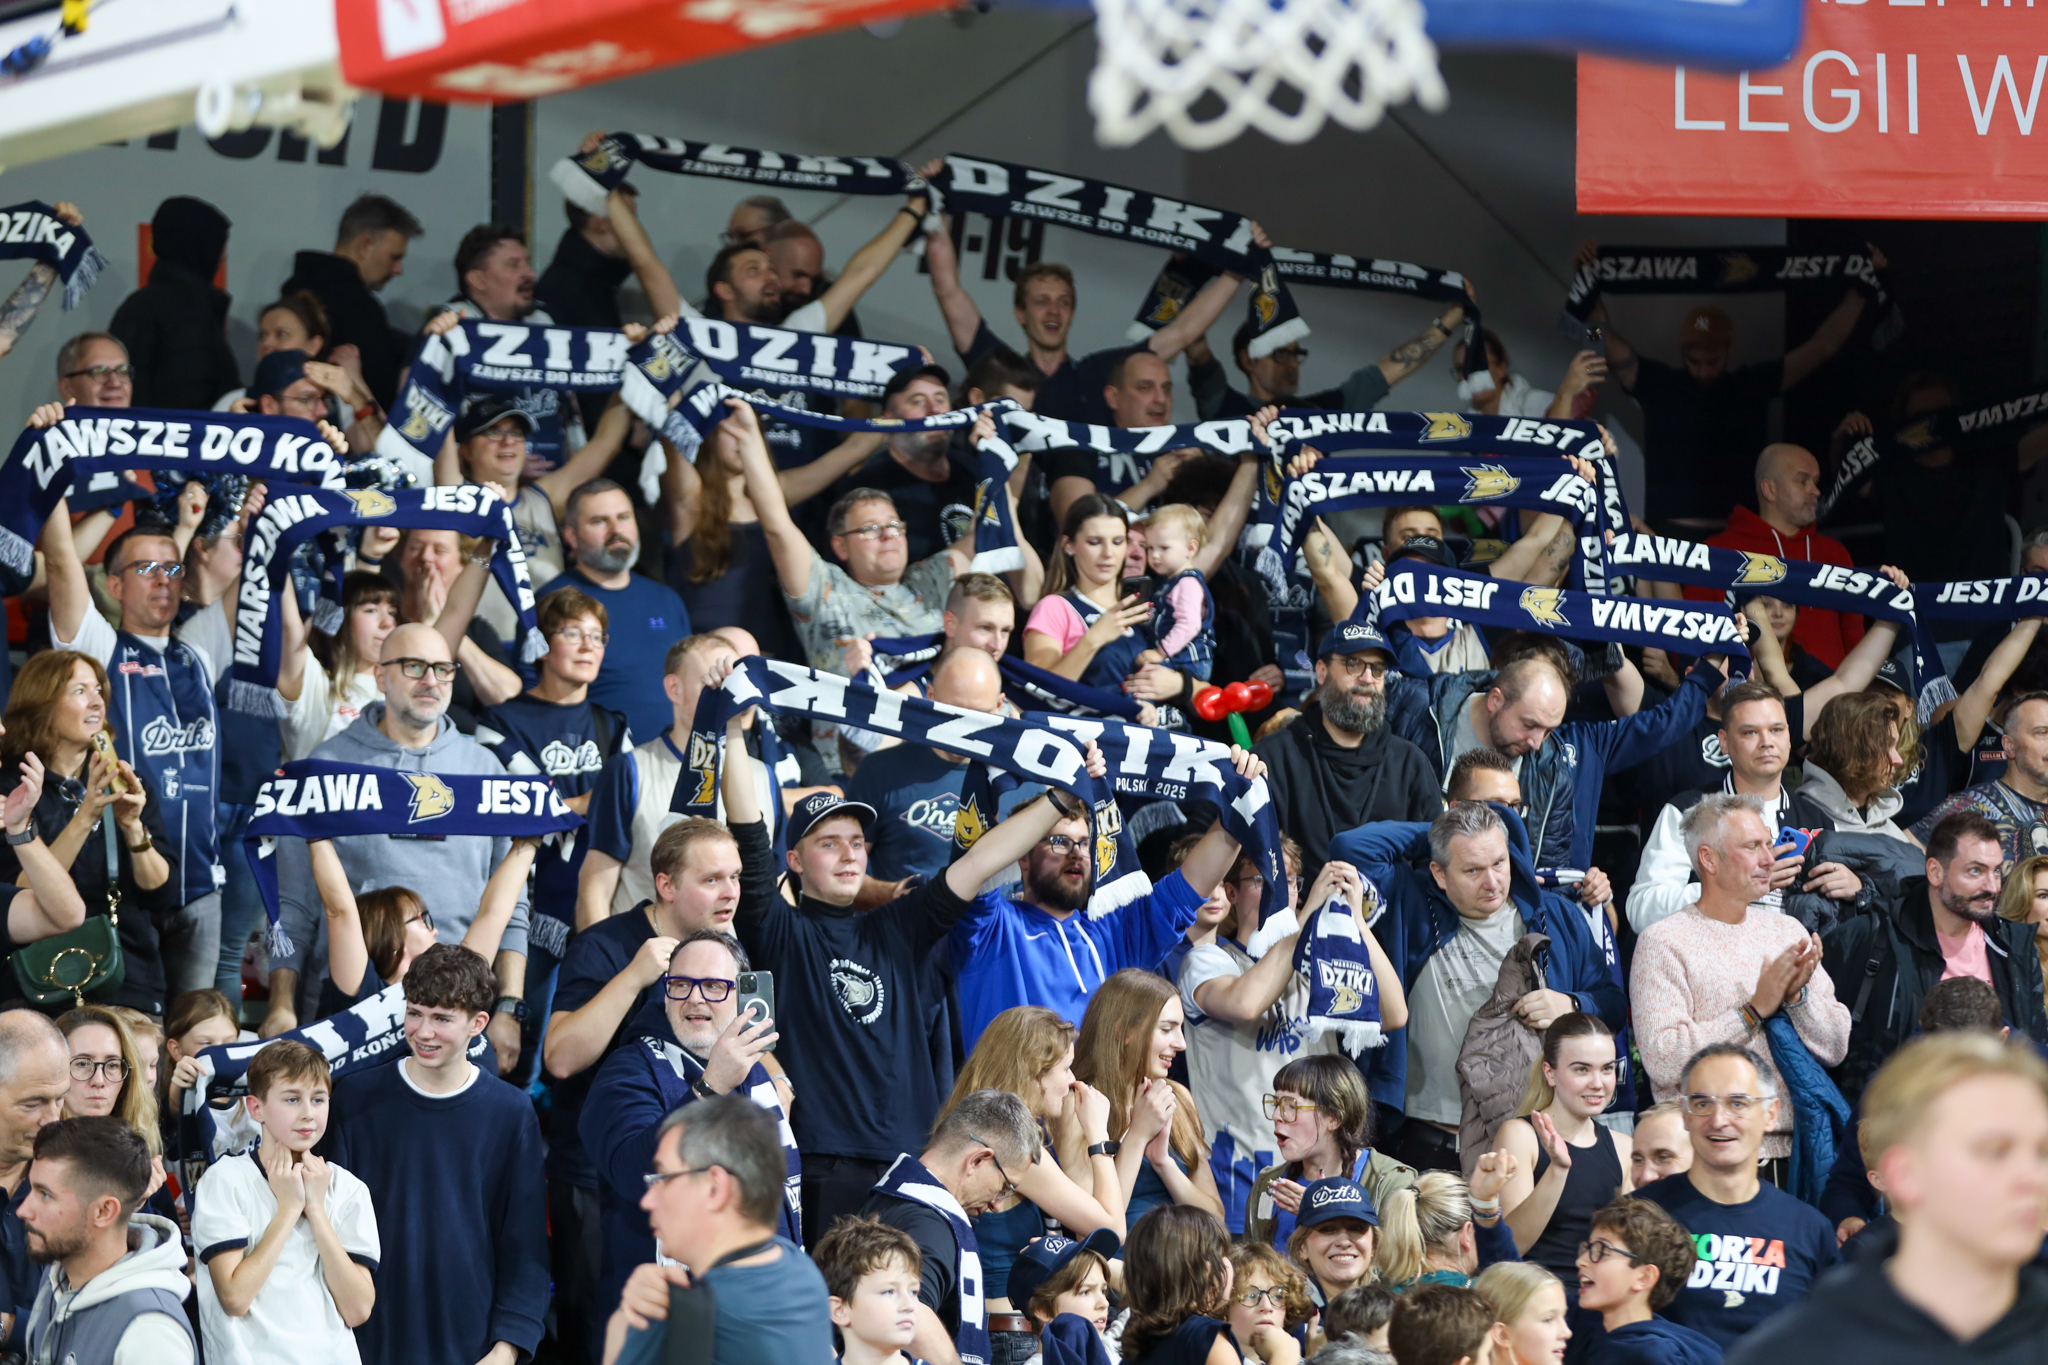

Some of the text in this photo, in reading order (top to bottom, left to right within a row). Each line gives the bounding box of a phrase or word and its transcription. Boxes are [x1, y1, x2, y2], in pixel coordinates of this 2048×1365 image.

[1675, 50, 1919, 134] LEGII
[1010, 200, 1093, 227] ZAWSZE
[1097, 217, 1125, 235] DO
[1276, 262, 1326, 278] WSZE
[1329, 267, 1354, 280] DO
[1775, 256, 1840, 280] JEST
[471, 363, 544, 384] ZAWSZE
[545, 369, 569, 385] DO
[740, 366, 809, 386] ZAWSZE
[810, 376, 833, 391] DO
[1496, 418, 1585, 450] JEST
[22, 418, 192, 491] ZAWSZE
[200, 424, 265, 465] DO
[233, 494, 330, 667] WARSZAWA
[421, 485, 501, 517] JEST
[1607, 533, 1896, 600] ZAWA JEST
[1423, 574, 1499, 610] JEST
[1936, 577, 2012, 604] JEST
[477, 779, 550, 817] JEST
[1155, 782, 1187, 800] 2025
[907, 800, 960, 827] O'ne
[1321, 962, 1373, 994] DZIKI
[353, 1028, 406, 1062] KOŃC
[1312, 1184, 1363, 1208] Dziki
[1686, 1260, 1780, 1295] DZIKI
